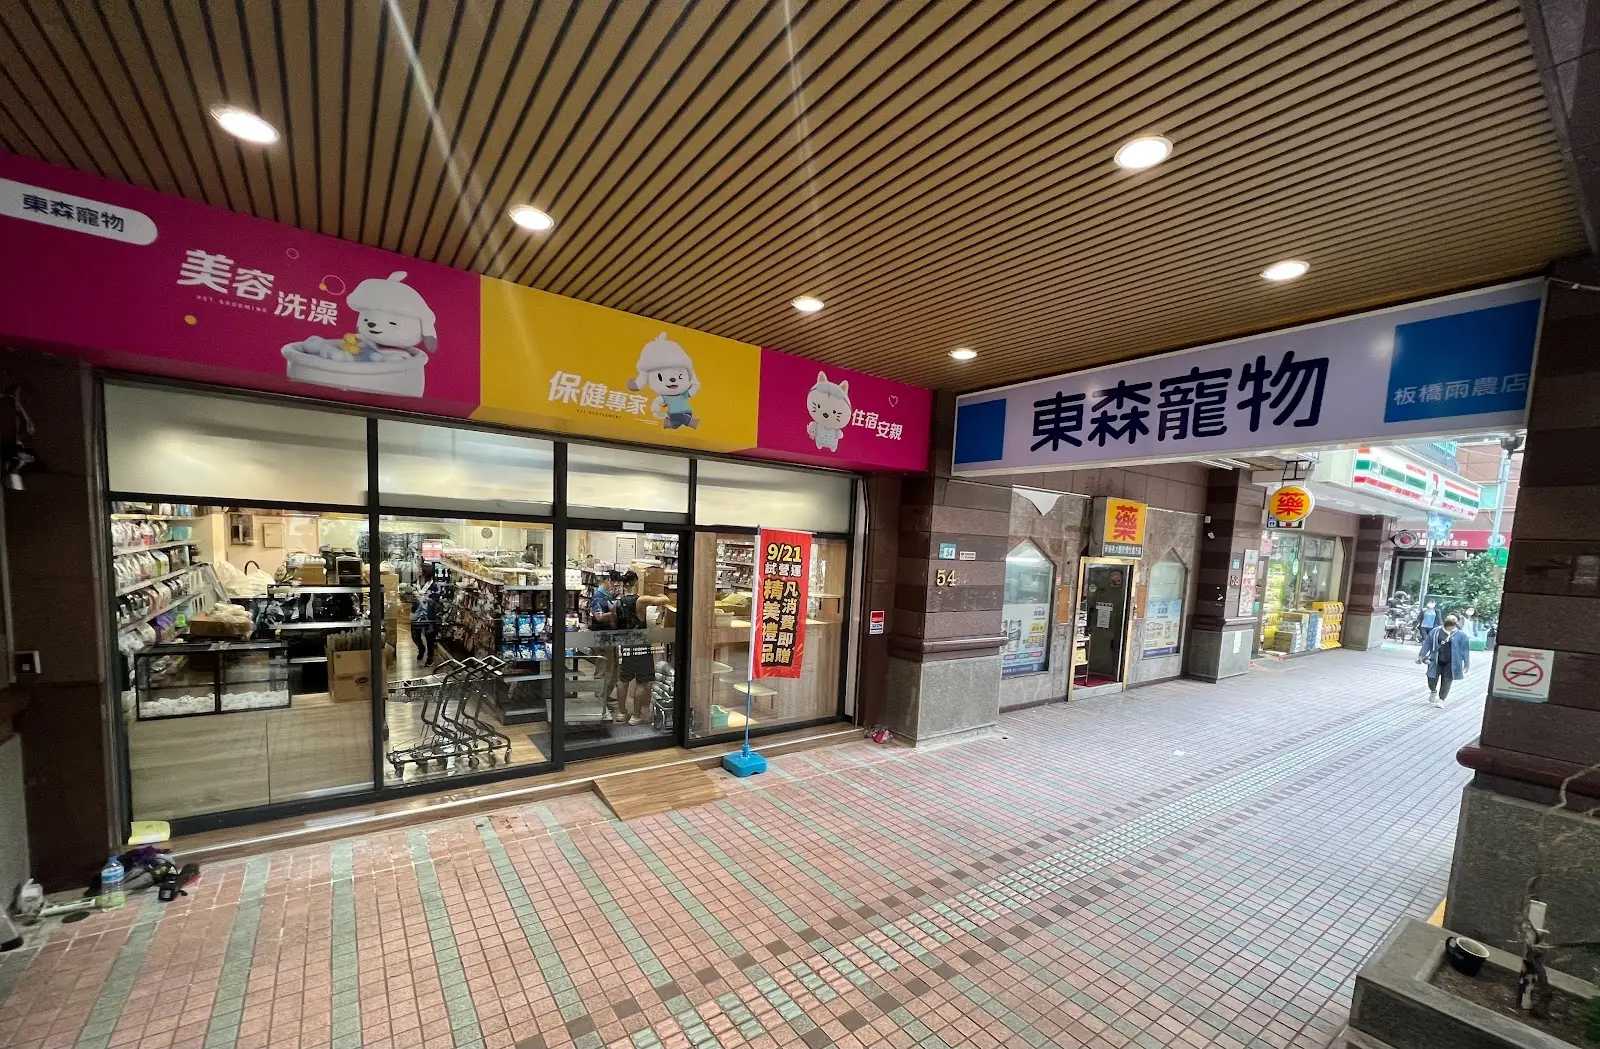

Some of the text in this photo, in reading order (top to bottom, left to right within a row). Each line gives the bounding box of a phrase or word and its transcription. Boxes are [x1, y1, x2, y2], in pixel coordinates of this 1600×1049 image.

[22, 193, 124, 232] 東森寵物
[548, 370, 649, 415] 保健專家
[1029, 351, 1330, 452] 東森寵物
[1394, 373, 1528, 405] 板橋雨農店
[1276, 492, 1305, 516] 藥
[1112, 505, 1138, 541] 藥
[765, 562, 802, 577] 試營運
[767, 543, 802, 562] 9/21
[936, 569, 956, 587] 54
[762, 579, 784, 664] 精美禮品
[775, 581, 799, 663] 凡消費即贈
